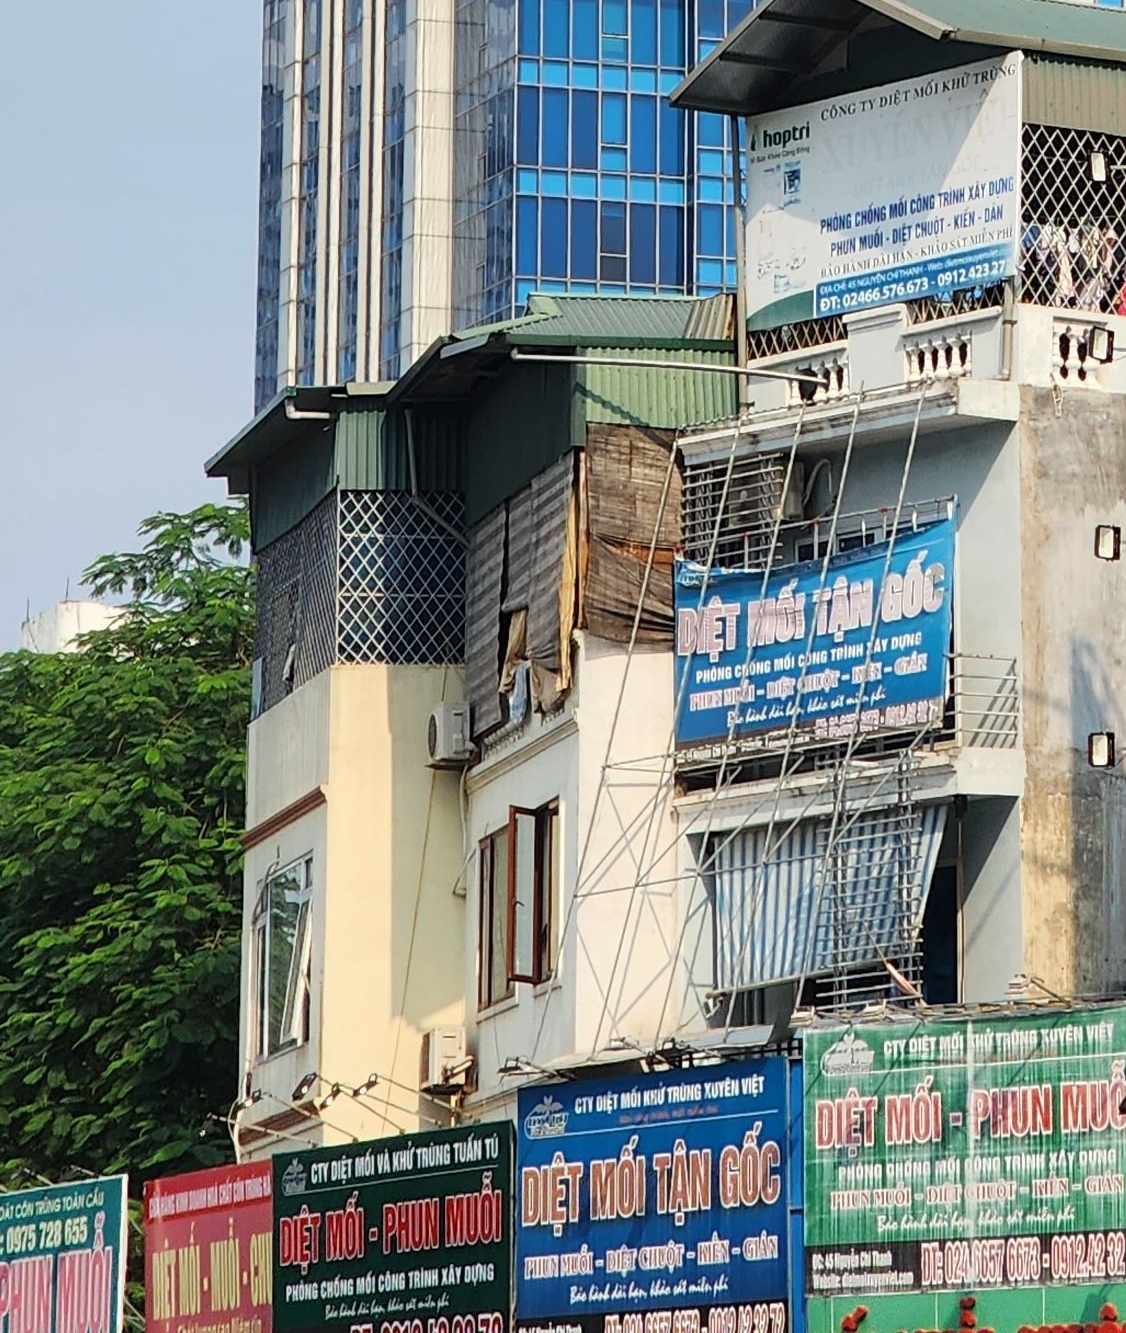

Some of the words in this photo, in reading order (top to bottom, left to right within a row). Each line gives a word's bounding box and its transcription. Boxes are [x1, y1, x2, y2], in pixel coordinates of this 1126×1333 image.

[821, 104, 856, 121] CÔNG
[860, 99, 877, 113] TY
[879, 90, 910, 107] DIỆT
[914, 79, 939, 100] MỐI
[942, 73, 970, 93] KHỬ
[974, 64, 1015, 85] TRÙNG
[763, 121, 810, 148] hoptri
[820, 214, 851, 234] PHÒNG
[855, 202, 886, 227] CHỐNG
[889, 197, 907, 220] MỐI
[910, 192, 935, 215] CÔNG
[938, 186, 965, 208] TRÌNH
[968, 181, 986, 202] XÂY
[988, 176, 1014, 198] DỰNG
[830, 238, 856, 257] PHUN
[892, 222, 912, 247] DIỆT
[915, 216, 945, 241] CHUỘT
[953, 209, 975, 229] KIẾN
[842, 255, 870, 274] HÀNH
[820, 297, 840, 312] ĐT:
[678, 595, 740, 663] DIỆT
[747, 578, 806, 648] MỐI
[812, 576, 874, 643] TẬN
[881, 549, 945, 623] GỐC
[696, 662, 731, 684] PHÒNG
[774, 650, 795, 672] MỐI
[831, 643, 863, 661] TRÌNH
[883, 1040, 906, 1057] CTY
[575, 1097, 595, 1114] CTY
[596, 1093, 619, 1113] DIỆT
[621, 1085, 642, 1109] MỐI
[644, 1082, 666, 1106] KHỬ
[667, 1082, 702, 1104] TRÙNG
[704, 1077, 740, 1100] XUYÊN
[742, 1074, 765, 1098] VIỆT
[815, 1087, 877, 1157] DIỆT
[885, 1075, 942, 1145] MỐI
[970, 1085, 1052, 1139] PHUN
[311, 1158, 331, 1184] CTY
[331, 1155, 353, 1184] DIỆT
[355, 1148, 375, 1177] MỐI
[377, 1149, 390, 1174] VÀ
[392, 1140, 415, 1172] KHỬ
[415, 1142, 451, 1169] TRÙNG
[453, 1133, 483, 1164] TUẤN
[485, 1133, 499, 1159] TÚ
[521, 1151, 583, 1237] DIỆT
[590, 1135, 647, 1220] MỐI
[653, 1139, 712, 1226] TẬN
[719, 1120, 781, 1209] GỐC
[16, 1201, 34, 1218] CÔN
[35, 1195, 61, 1214] TRÙNG
[62, 1192, 84, 1211] TOÀN
[280, 1204, 320, 1275] DIỆT
[326, 1191, 365, 1262] MỐI
[382, 1198, 440, 1254] PHUN
[444, 1170, 502, 1248] MUỖI
[6, 1221, 36, 1254] 0975
[39, 1219, 62, 1250] 728
[65, 1214, 88, 1244] 655
[524, 1255, 559, 1280] PHUN
[606, 1245, 637, 1277] DIỆT
[639, 1240, 685, 1273] CHUỘT
[1007, 1237, 1041, 1282] 6673
[1107, 1233, 1125, 1276] 32
[286, 1281, 319, 1302] PHÒNG
[320, 1273, 354, 1299] CHỐNG
[356, 1269, 376, 1295] MỐI
[378, 1267, 406, 1293] CÔNG
[408, 1266, 439, 1289] TRÌNH
[441, 1265, 461, 1284] XÂY
[464, 1262, 495, 1287] DỰNG
